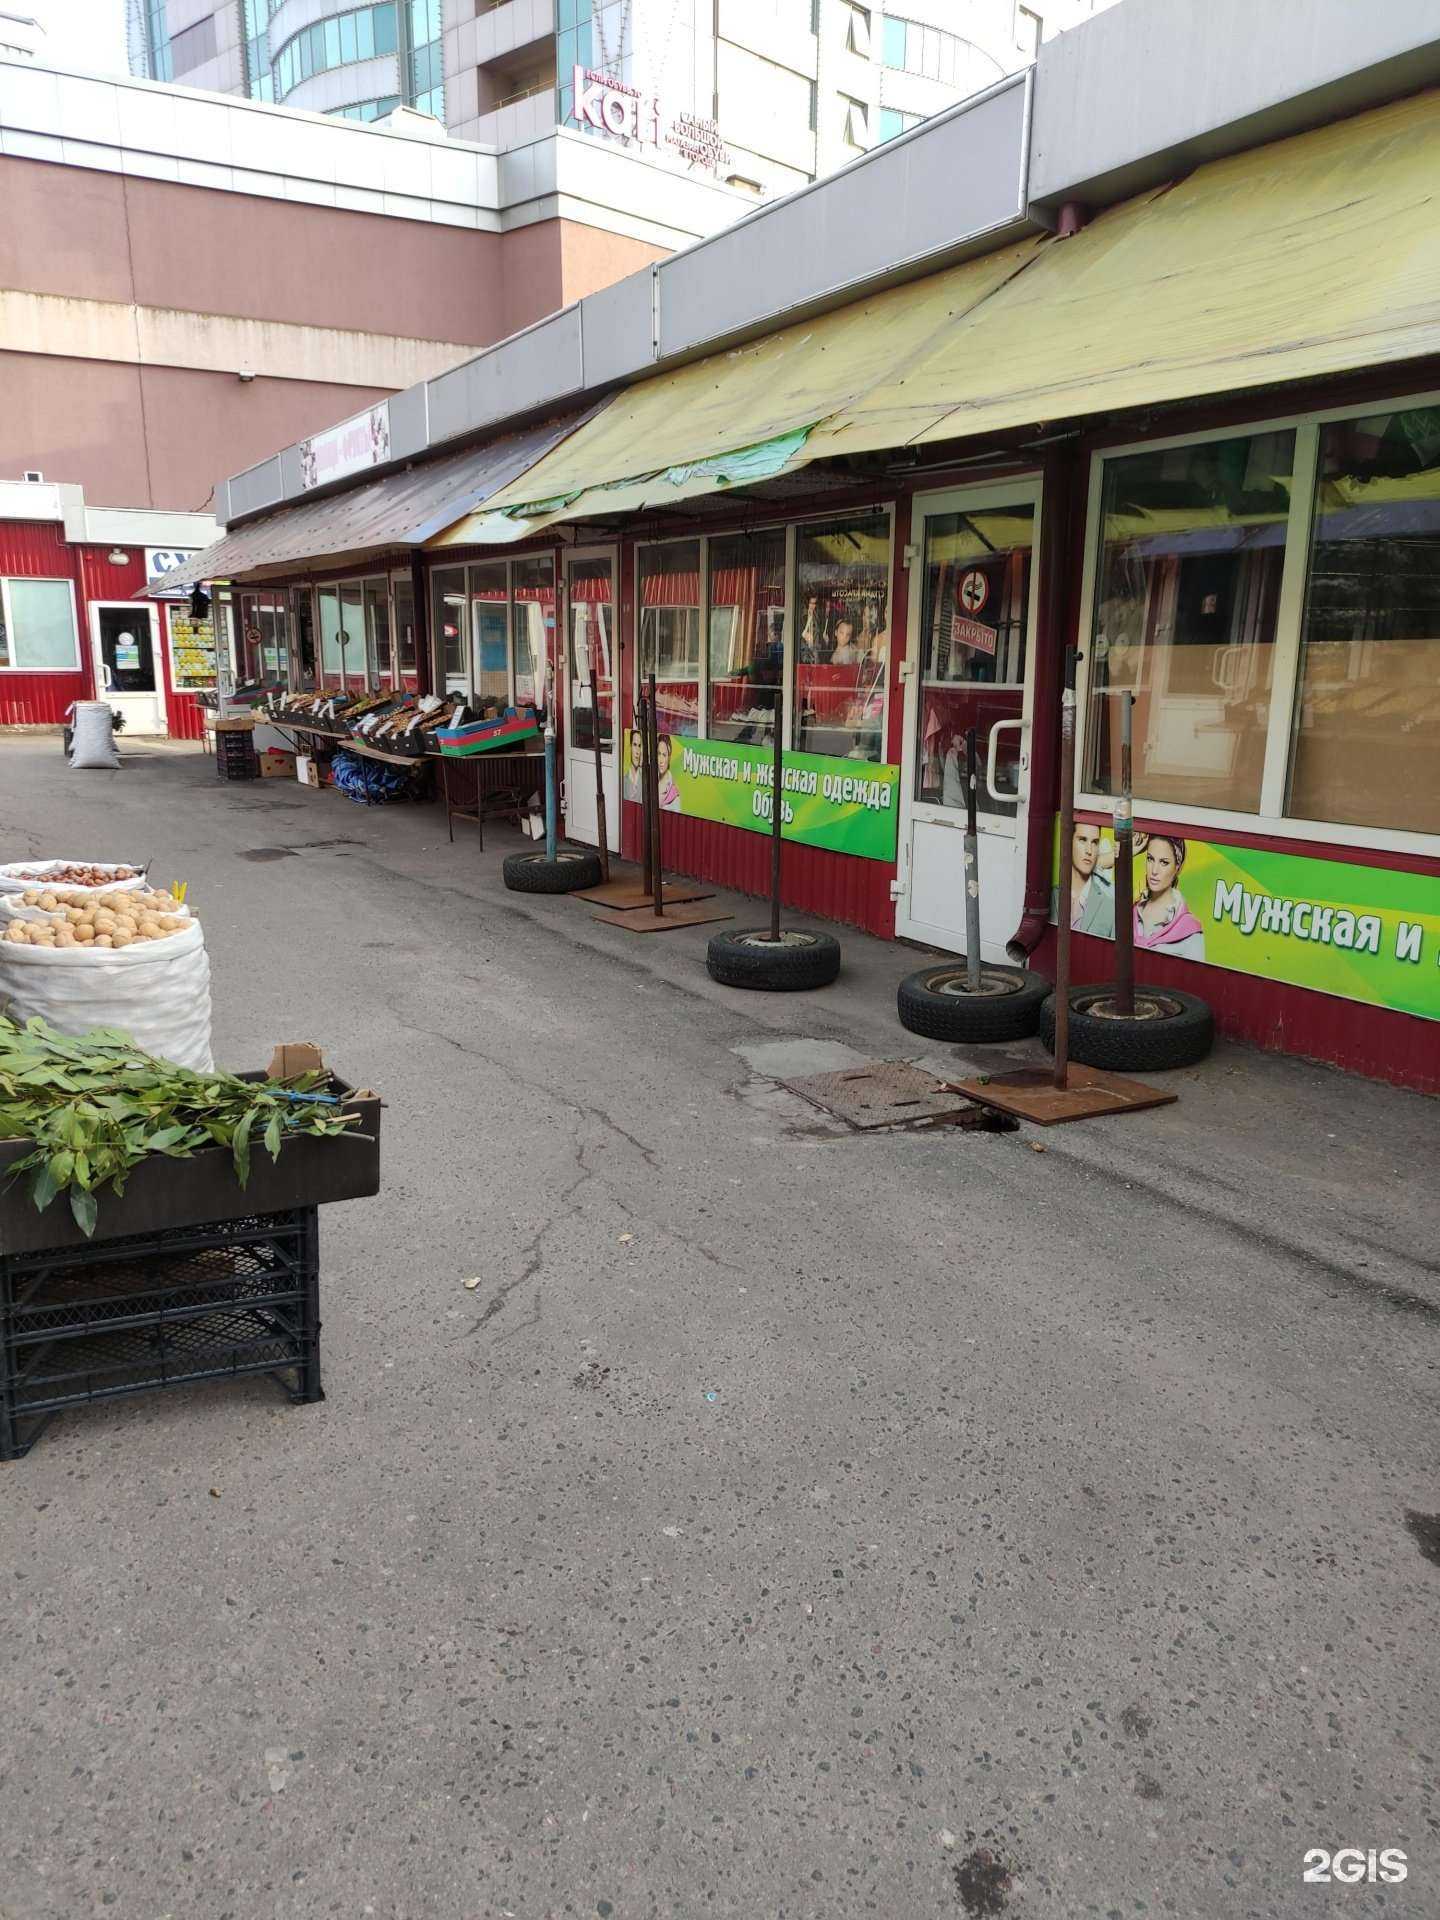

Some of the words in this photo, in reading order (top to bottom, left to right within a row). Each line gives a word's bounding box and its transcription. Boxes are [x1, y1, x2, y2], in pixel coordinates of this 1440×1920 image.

[954, 622, 993, 648] ЗАКРЫТО
[683, 748, 738, 781] Мужская
[743, 764, 752, 783] и
[822, 774, 892, 810] одежда
[1213, 878, 1381, 954] Мужская
[1395, 921, 1424, 962] и
